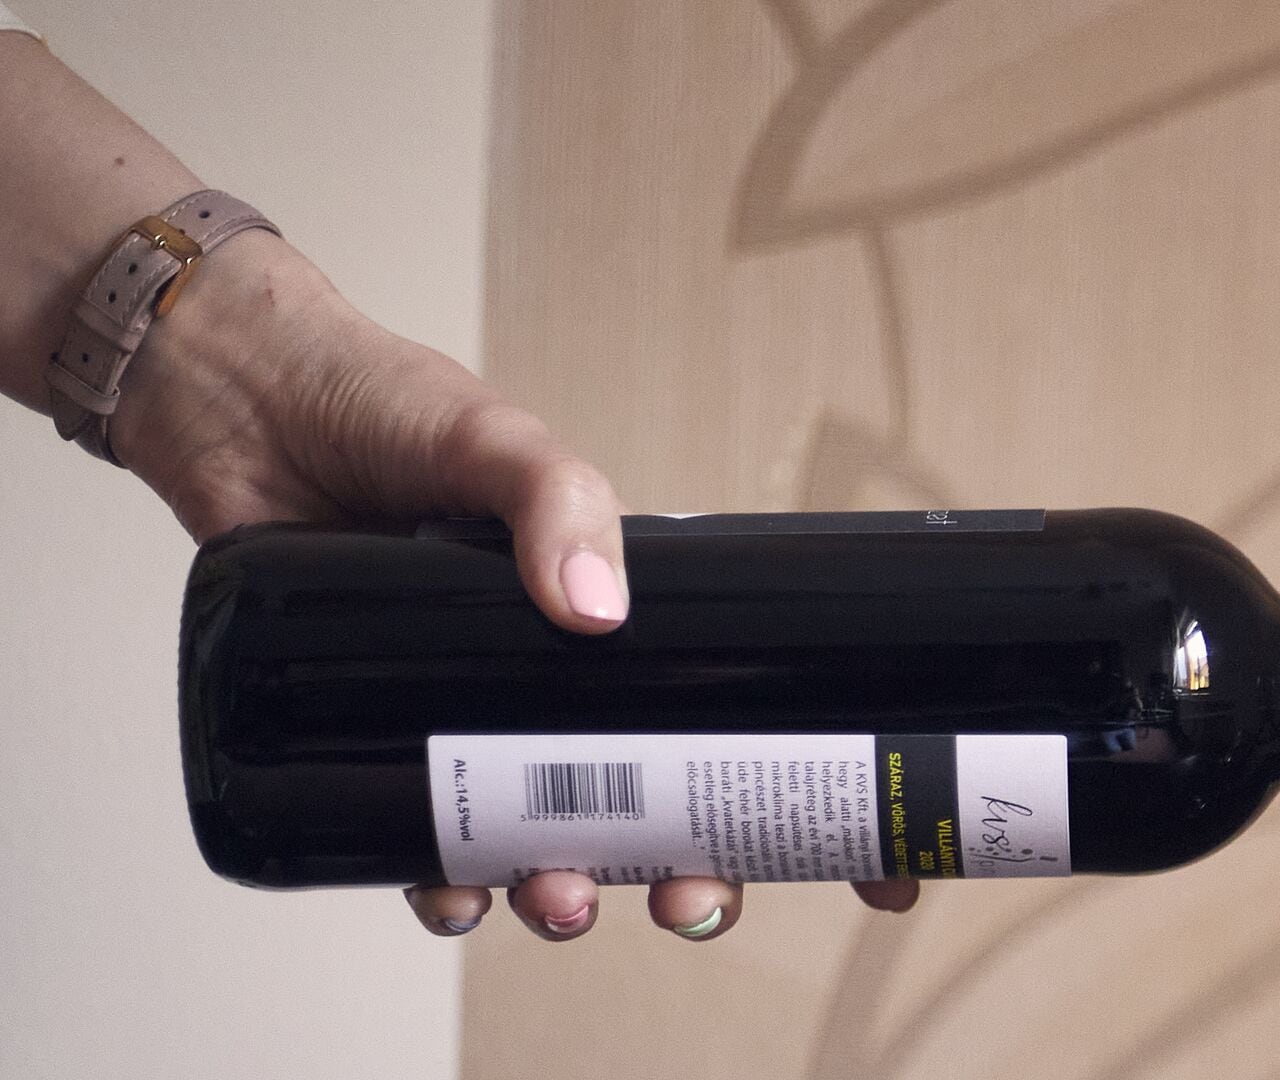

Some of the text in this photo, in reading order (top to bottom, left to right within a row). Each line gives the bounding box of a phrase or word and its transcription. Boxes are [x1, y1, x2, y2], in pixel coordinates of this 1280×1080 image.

[720, 761, 734, 793] baráti
[738, 761, 749, 783] üde
[788, 761, 800, 792] feletti
[836, 761, 850, 789] hegy
[856, 761, 865, 769] A
[888, 752, 904, 800] SZÁRAZ,
[702, 761, 717, 801] esetleg
[752, 761, 767, 811] pincészet
[771, 761, 784, 820] mikroklíma
[802, 761, 816, 812] talajréteg
[820, 761, 836, 823] helyezkedik
[855, 773, 867, 794] KVS
[739, 789, 751, 815] fehér
[840, 797, 852, 821] alatti
[857, 798, 868, 814] Kft.
[520, 814, 527, 822] 5
[590, 813, 640, 821] 174140
[705, 803, 721, 847] elősegítve
[807, 815, 816, 825] az
[891, 803, 907, 837] VÖRÖS,
[741, 821, 755, 852] borokat
[757, 817, 772, 862] tradicionális
[774, 824, 786, 843] teszi
[809, 828, 819, 840] évi
[810, 843, 822, 855] 700
